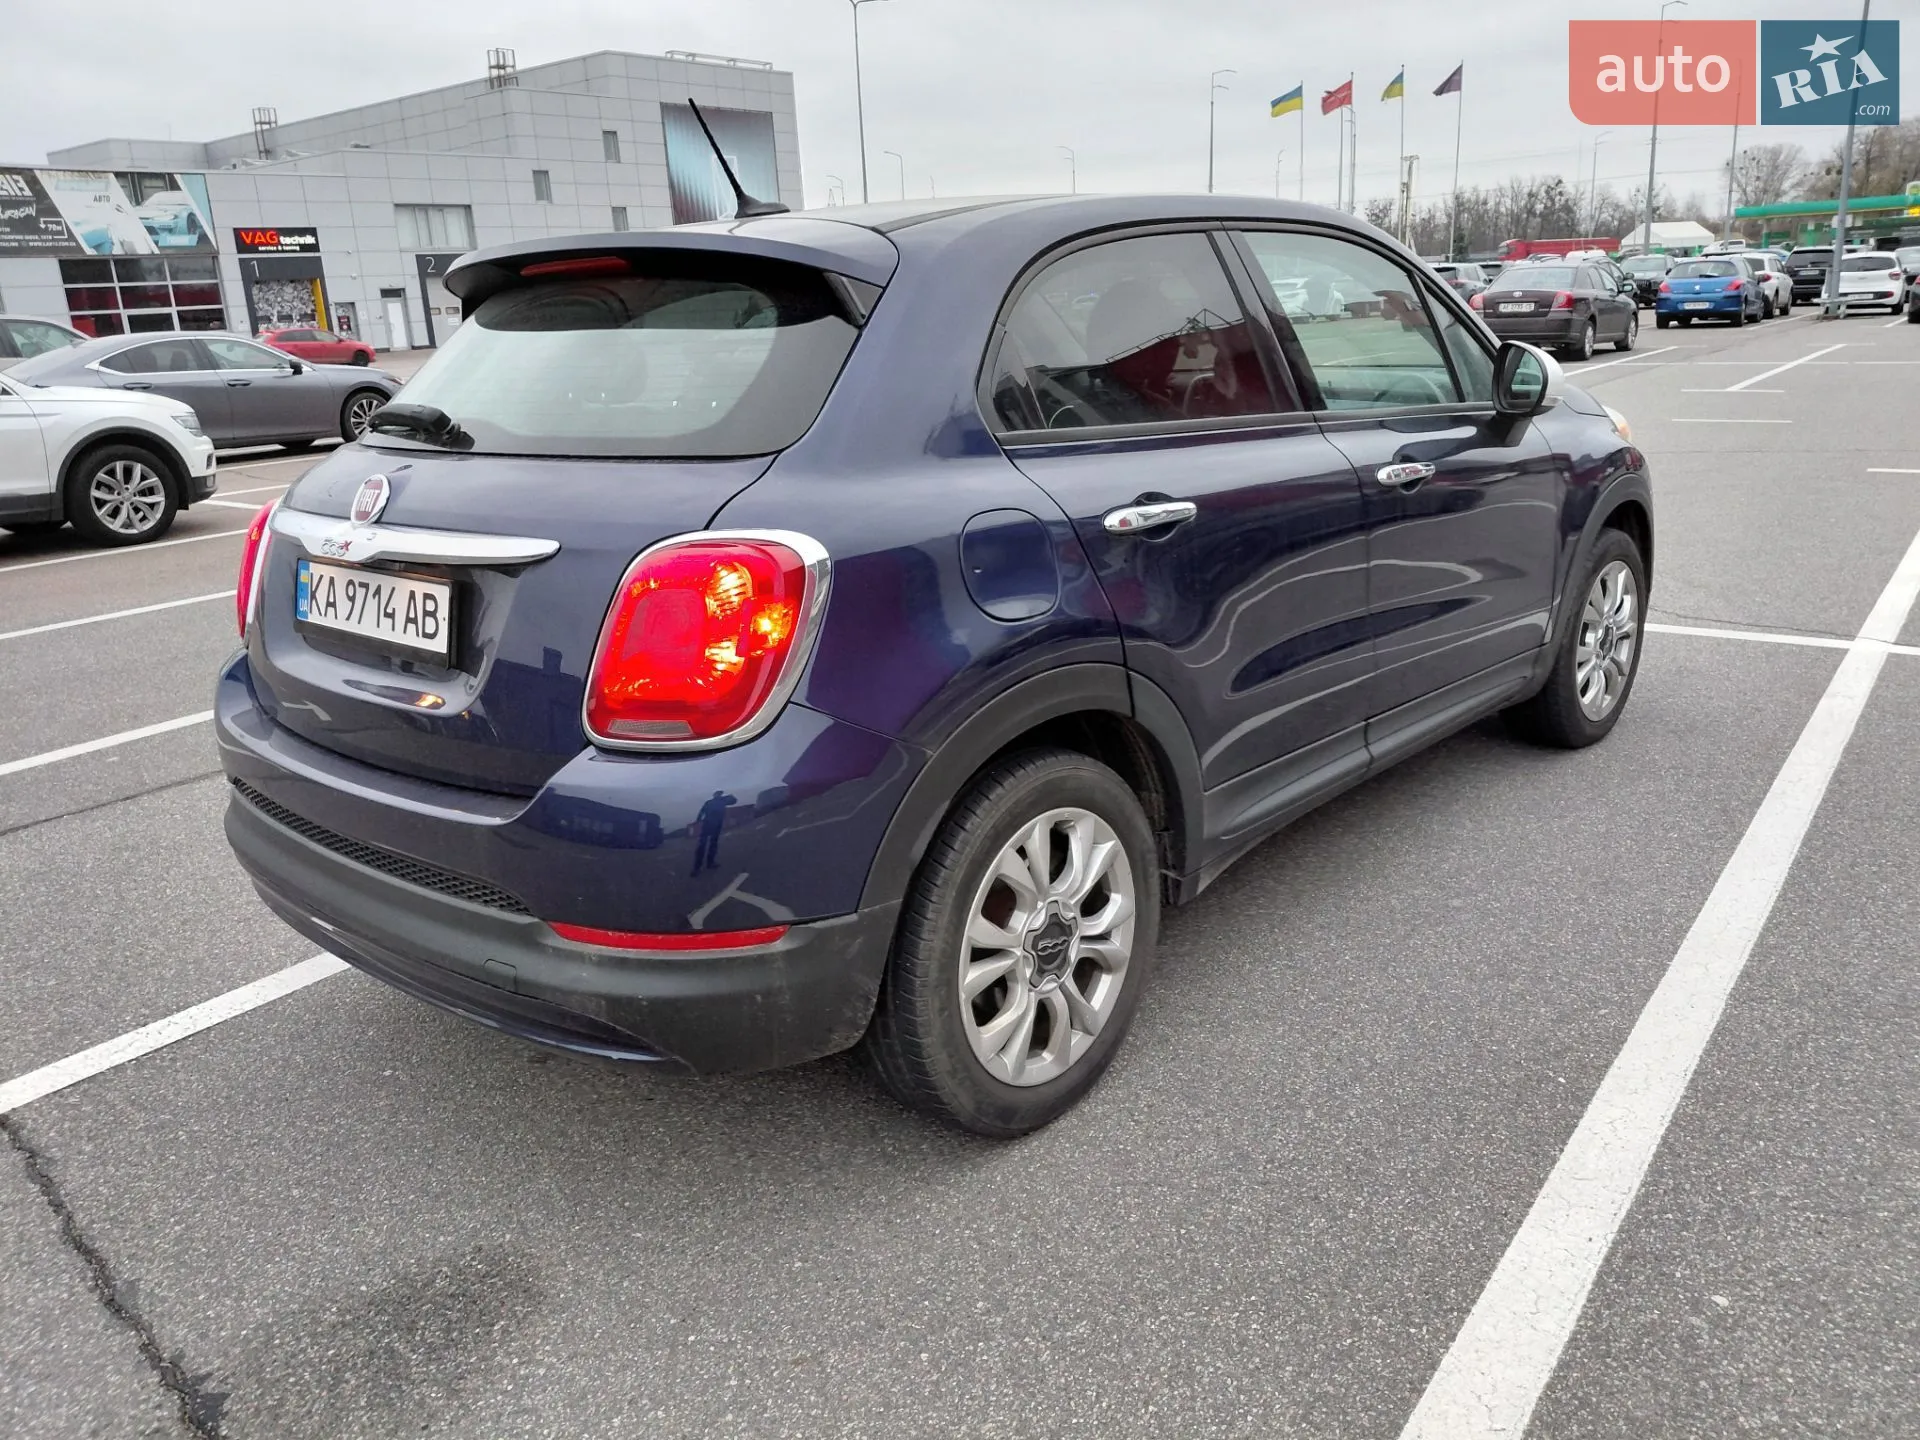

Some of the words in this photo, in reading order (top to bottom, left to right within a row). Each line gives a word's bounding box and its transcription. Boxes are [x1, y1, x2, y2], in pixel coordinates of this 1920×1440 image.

[240, 230, 279, 245] VAG
[279, 234, 317, 245] technik
[250, 260, 259, 278] 1
[425, 256, 437, 273] 2
[356, 488, 381, 512] FIAT
[300, 600, 308, 611] UA
[309, 572, 338, 620] KA
[345, 579, 396, 632] 9714
[403, 589, 440, 640] AB
